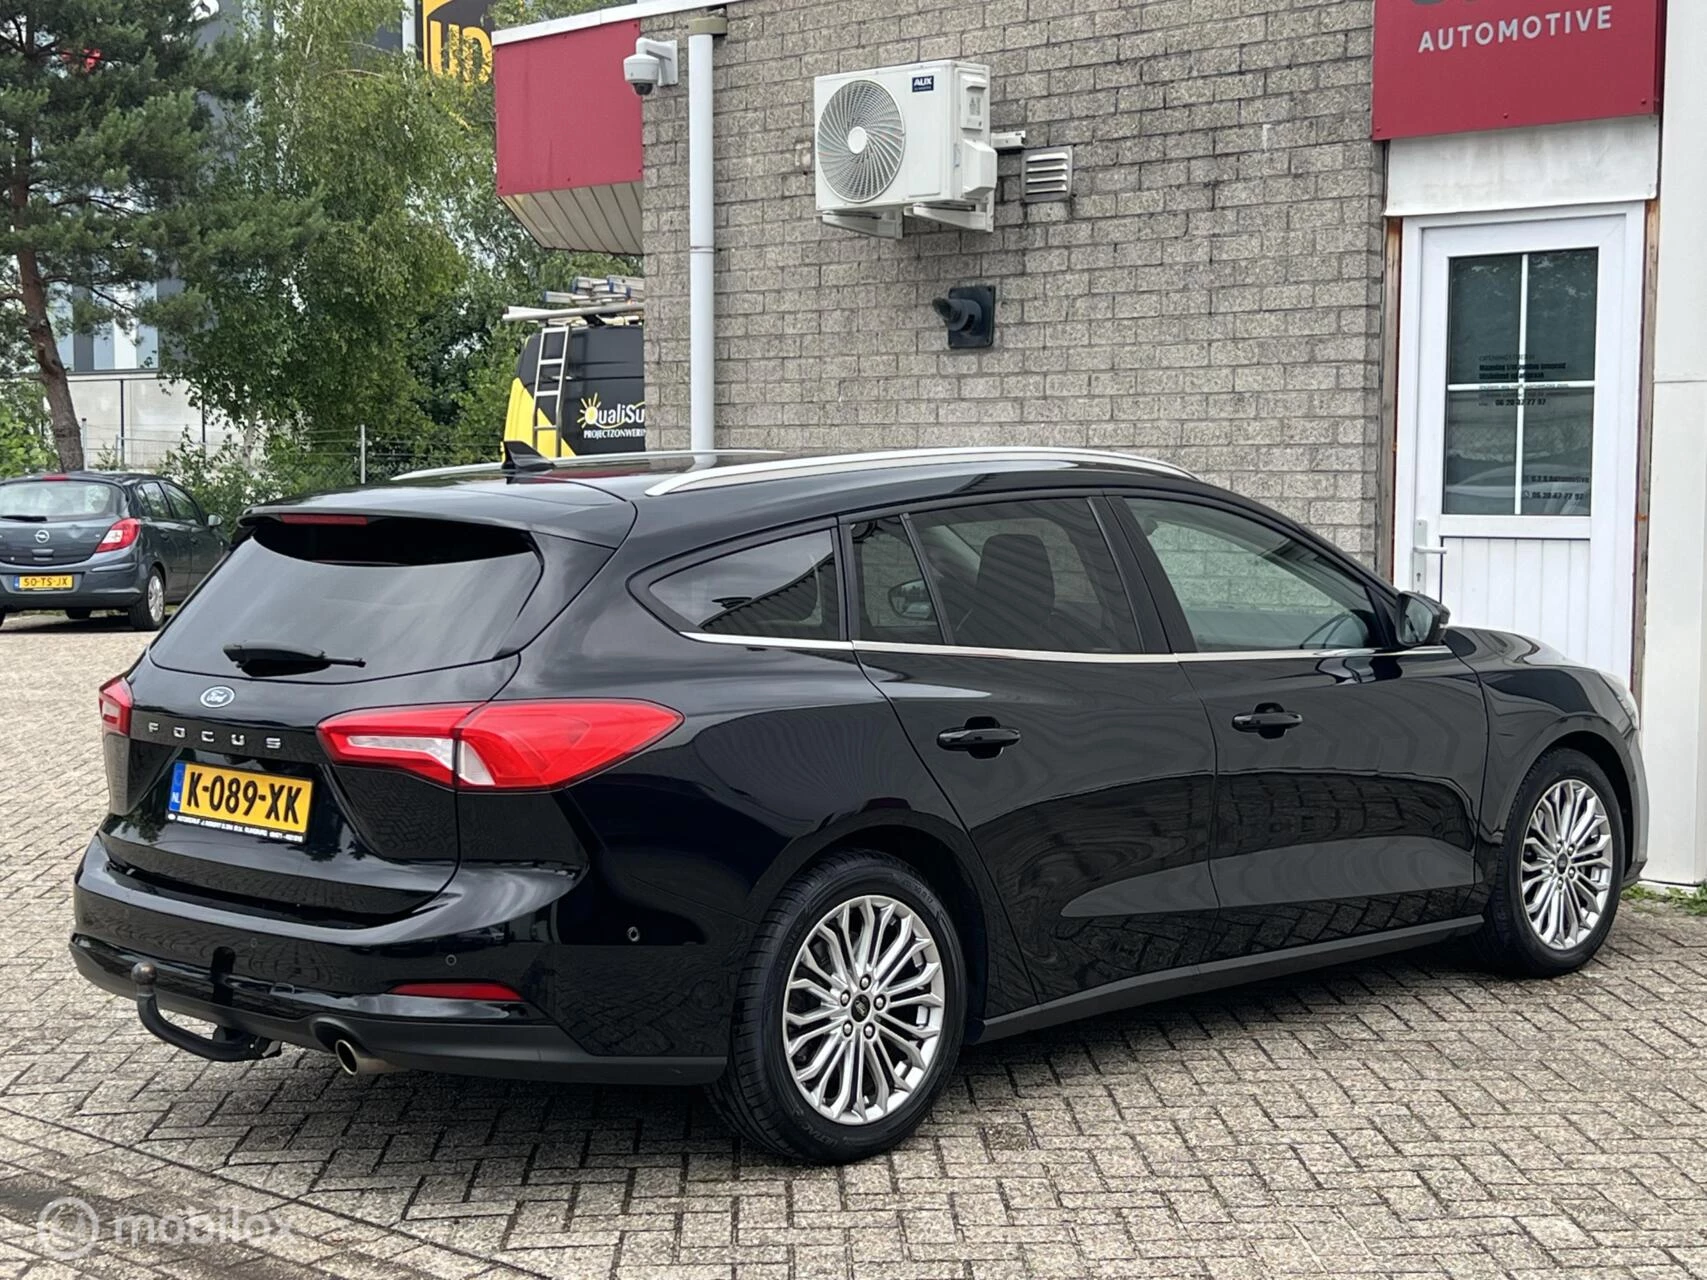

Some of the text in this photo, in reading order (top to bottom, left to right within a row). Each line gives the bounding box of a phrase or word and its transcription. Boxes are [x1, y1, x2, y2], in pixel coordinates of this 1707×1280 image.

[1417, 5, 1613, 53] AUTOMOTIVE
[914, 77, 932, 86] AUX
[148, 721, 282, 750] FOCUS
[170, 791, 181, 804] NL
[186, 770, 303, 825] K-089-XK
